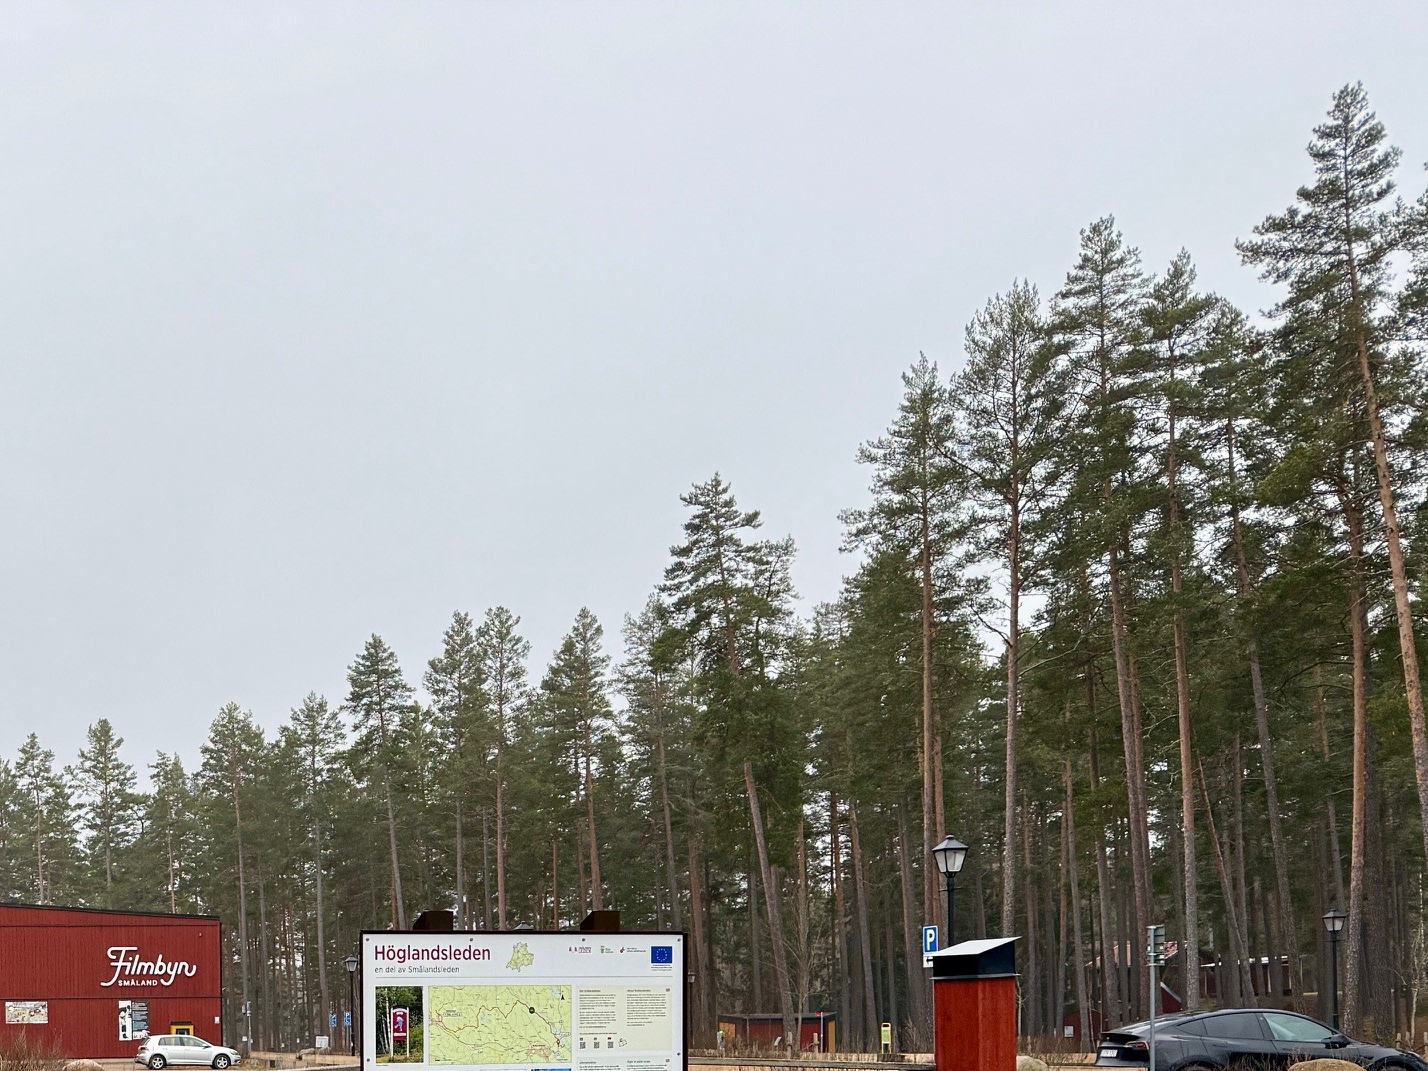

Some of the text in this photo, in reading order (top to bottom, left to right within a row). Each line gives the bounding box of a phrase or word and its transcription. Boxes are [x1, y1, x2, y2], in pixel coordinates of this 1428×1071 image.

[926, 929, 935, 951] P
[374, 944, 491, 964] Höglandsleden
[100, 946, 197, 986] Filmbyn
[385, 965, 395, 973] del
[408, 965, 460, 973] Smålandsleden
[118, 979, 158, 987] SMÅLAND
